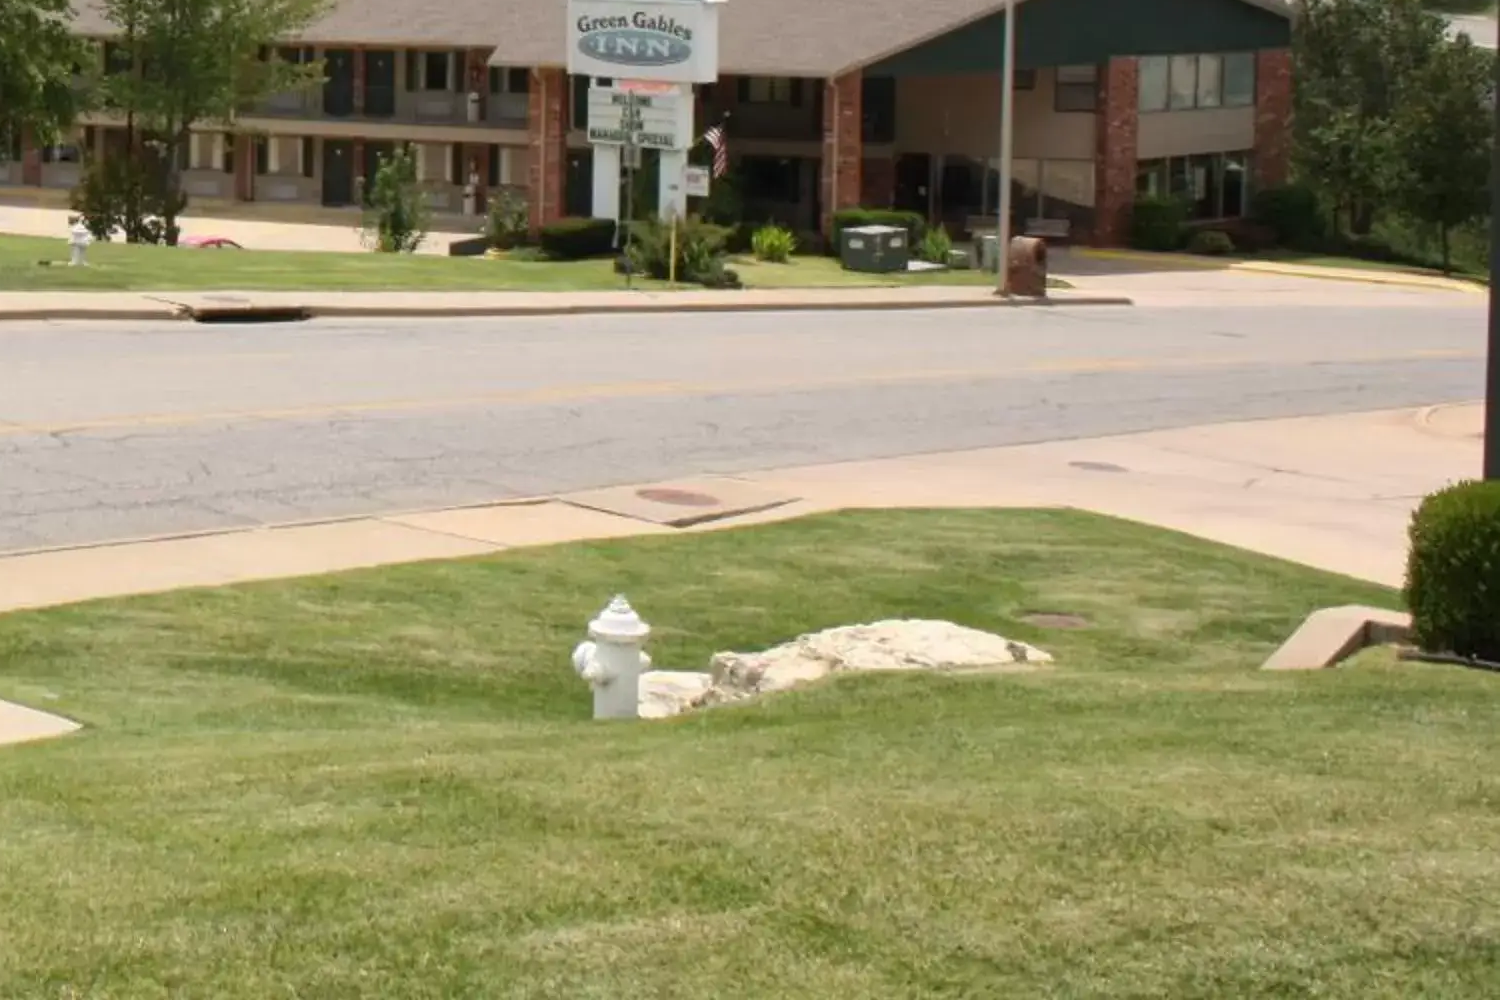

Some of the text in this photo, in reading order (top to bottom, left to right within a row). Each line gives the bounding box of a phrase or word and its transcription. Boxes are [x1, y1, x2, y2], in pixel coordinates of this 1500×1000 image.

[577, 11, 692, 40] Green Gables
[595, 35, 670, 57] INN
[611, 95, 651, 107] WELOME
